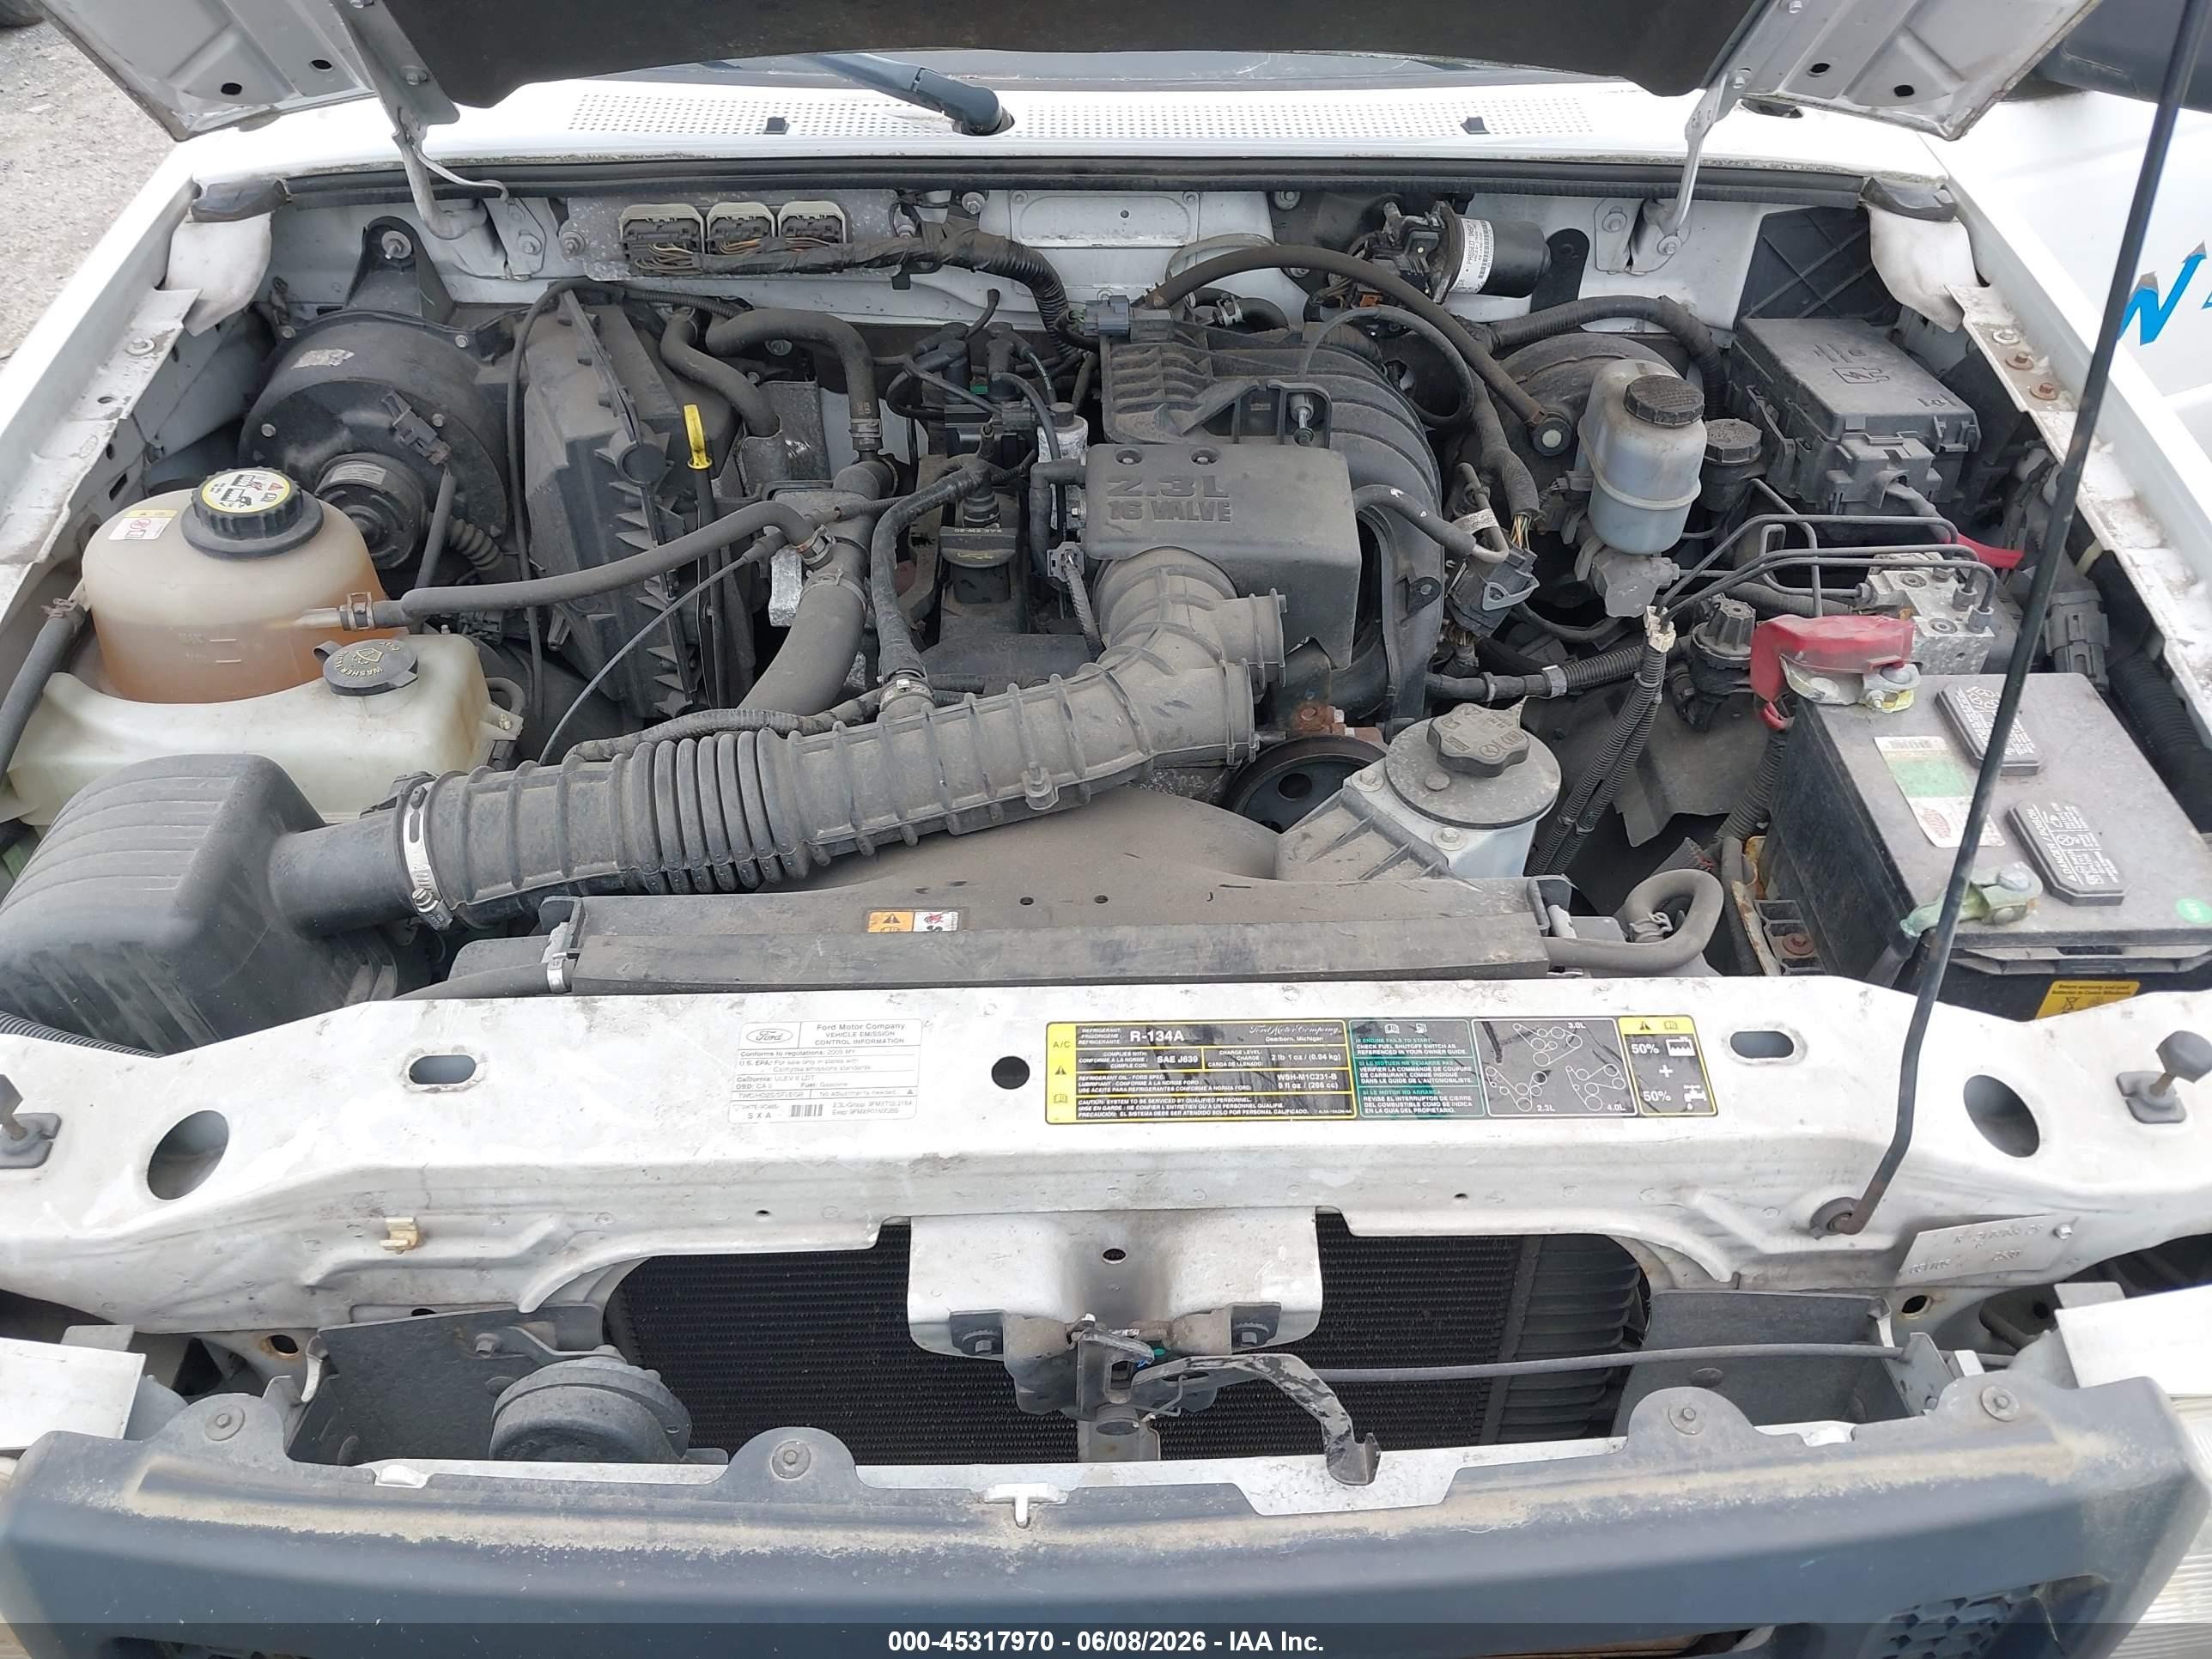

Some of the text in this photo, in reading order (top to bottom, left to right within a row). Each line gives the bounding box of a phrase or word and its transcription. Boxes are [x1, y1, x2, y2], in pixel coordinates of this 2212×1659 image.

[1106, 474, 1230, 498] 2.3L
[1108, 501, 1231, 521] 16 VALVE
[340, 666, 384, 678] WASHER
[756, 1030, 783, 1041] Ford
[1130, 1030, 1184, 1042] R-134A
[1053, 1040, 1071, 1049] A/C
[1631, 1043, 1660, 1054] 50%
[1177, 1054, 1199, 1064] J639
[1328, 1053, 1341, 1061] kg)
[1643, 1091, 1672, 1102] 50%
[1537, 1103, 1556, 1112] 2.3L
